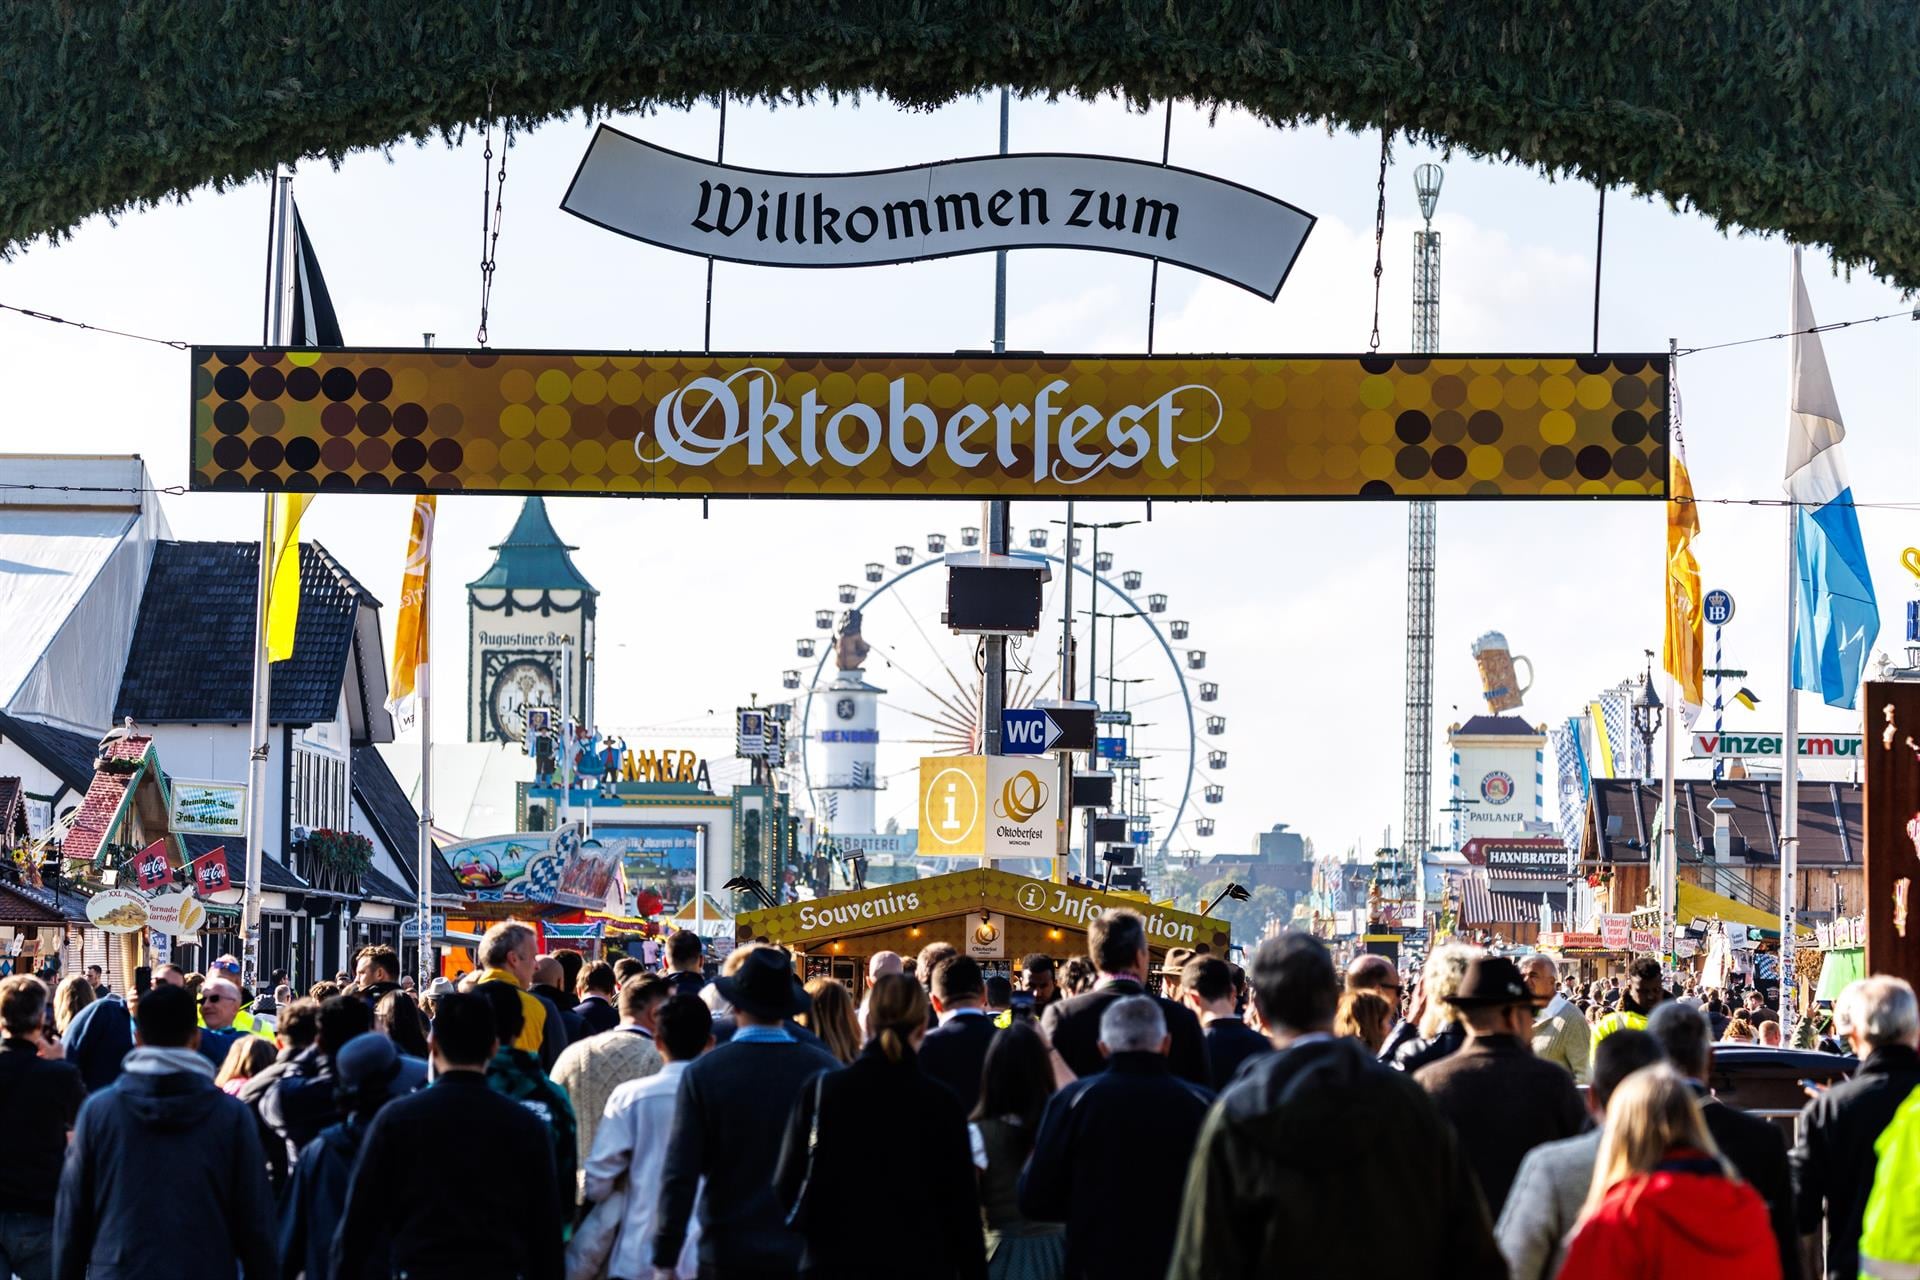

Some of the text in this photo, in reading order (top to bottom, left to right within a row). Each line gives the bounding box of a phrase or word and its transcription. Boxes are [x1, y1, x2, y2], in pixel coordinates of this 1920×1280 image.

[692, 180, 1180, 245] Willkommen zum
[634, 367, 1223, 485] Oktoberfest
[478, 631, 576, 648] Augustiner-Bru
[1006, 720, 1044, 744] WC
[175, 811, 196, 824] Foto
[1470, 812, 1524, 822] PAULANER
[996, 825, 1043, 841] Oktoberfest
[138, 856, 168, 878] Coca-Cola
[198, 863, 226, 882] Coca-Cola
[799, 891, 920, 931] Souvenirs
[1050, 889, 1194, 943] Infotion
